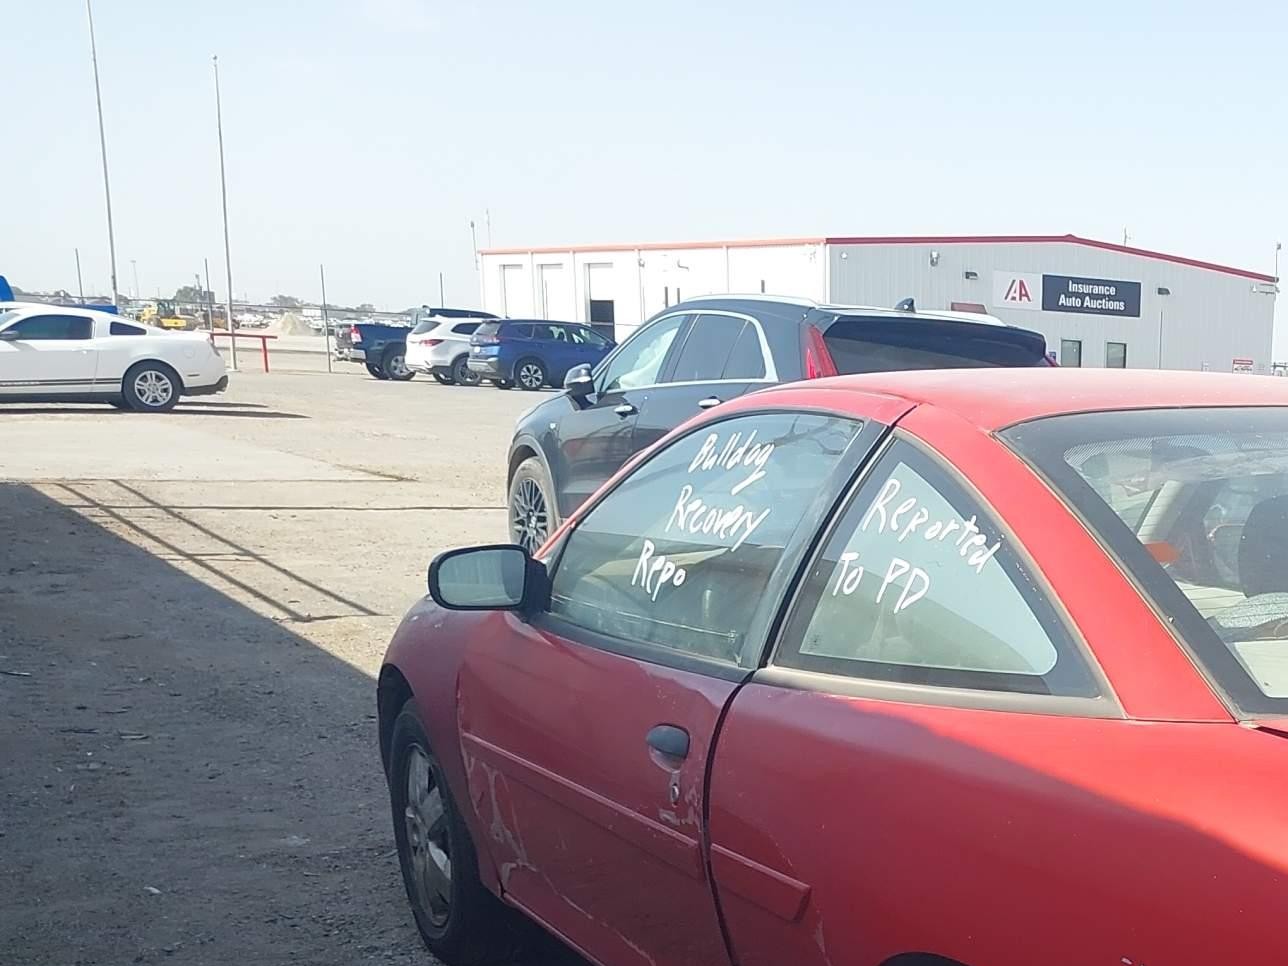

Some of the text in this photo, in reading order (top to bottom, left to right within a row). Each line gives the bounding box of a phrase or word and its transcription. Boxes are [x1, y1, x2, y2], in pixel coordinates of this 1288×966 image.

[1058, 293, 1125, 311] Auto Auctions
[1068, 280, 1116, 296] Insurance
[688, 430, 774, 495] Bulldog
[665, 484, 770, 552] Recovery
[862, 479, 1001, 574] Reported
[632, 539, 686, 601] Repo
[832, 552, 930, 614] To PD
